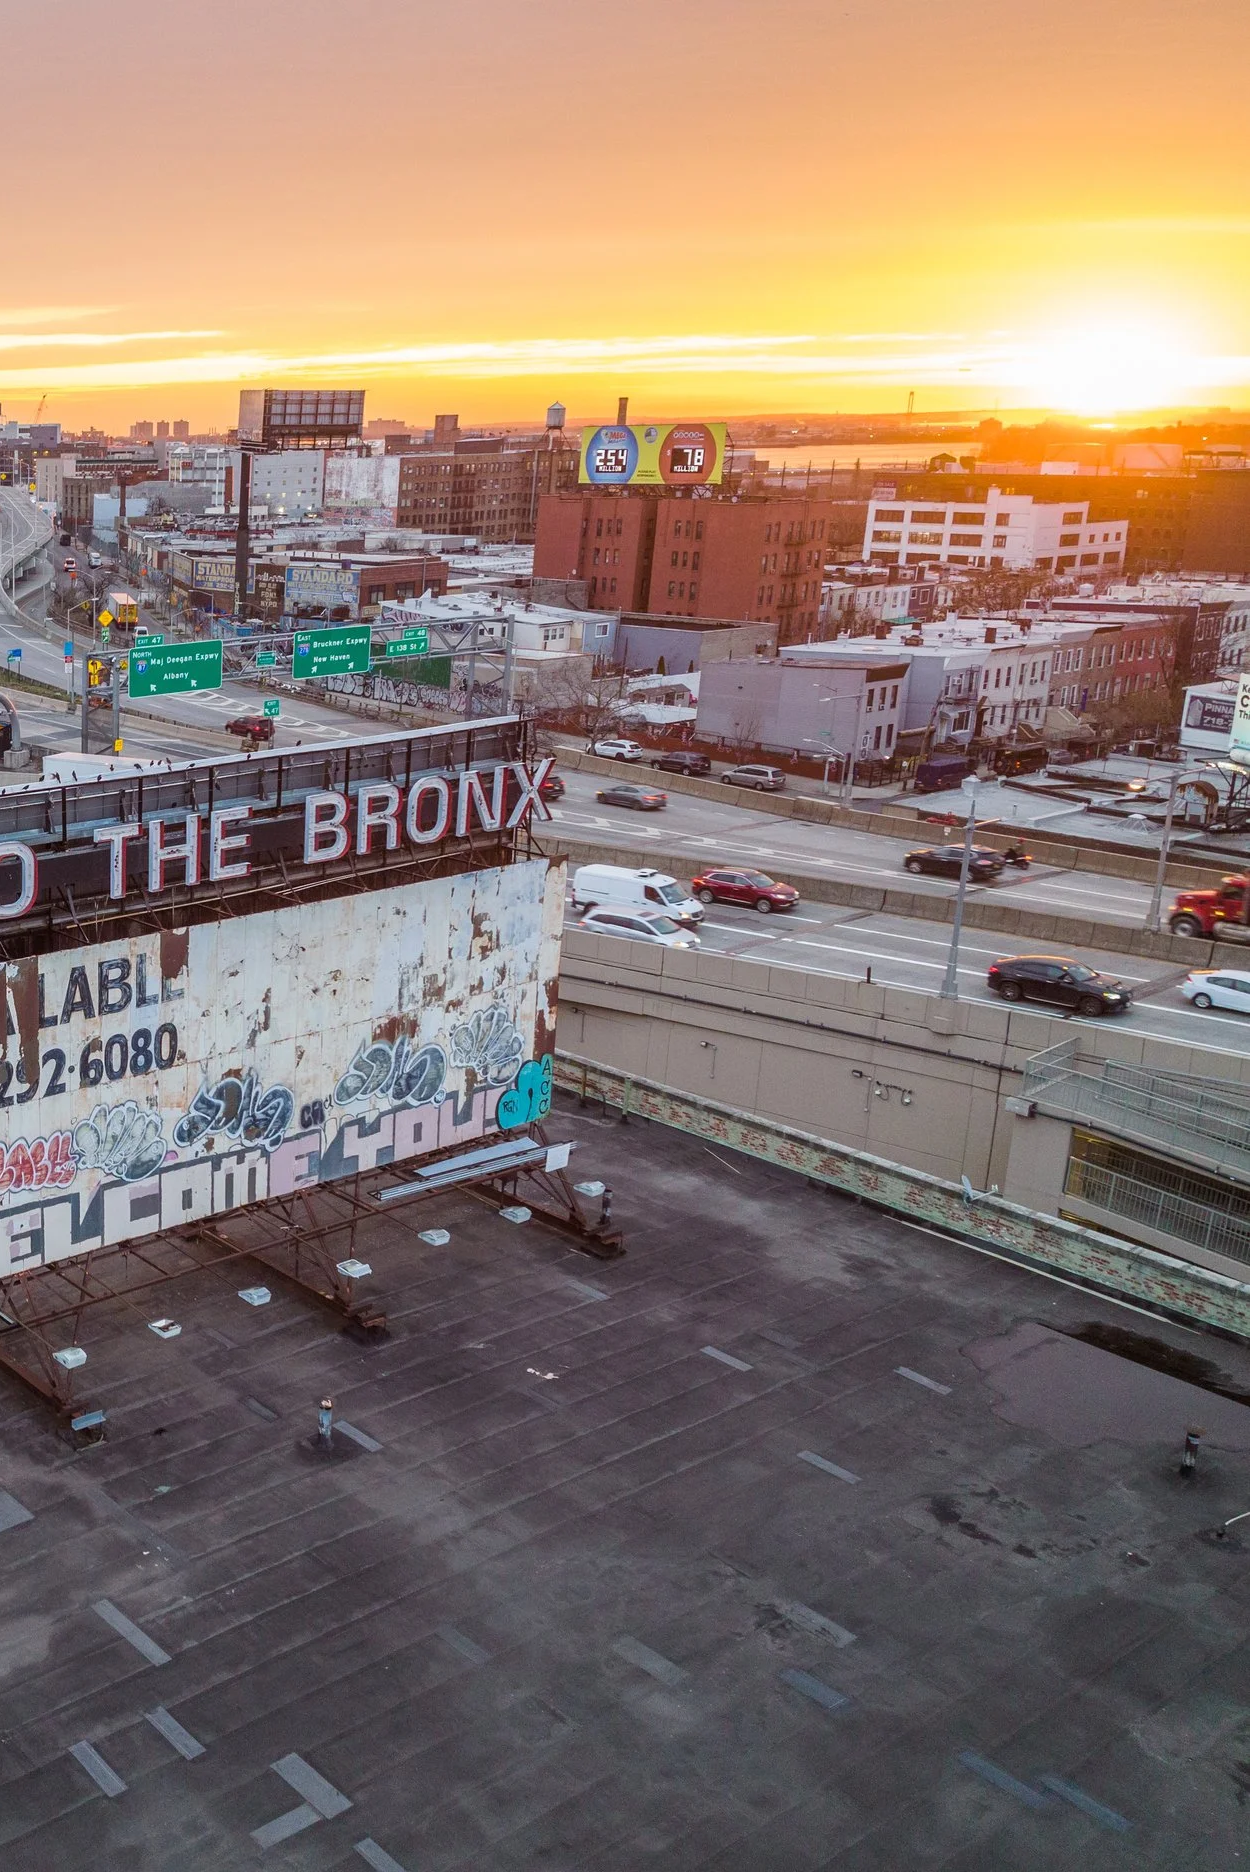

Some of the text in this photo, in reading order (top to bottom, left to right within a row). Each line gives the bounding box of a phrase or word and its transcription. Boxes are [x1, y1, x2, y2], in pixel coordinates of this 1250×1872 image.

[596, 449, 627, 466] 254
[683, 449, 705, 466] 78
[291, 568, 354, 585] STANDARD
[151, 636, 161, 644] 47
[297, 634, 311, 642] EAST
[313, 637, 368, 649] Bruckner Expwy
[396, 644, 408, 652] 138
[132, 651, 152, 659] NORTH
[150, 652, 219, 667] Maj Deegan Expwy
[313, 656, 328, 664] New
[163, 671, 189, 680] Albany
[92, 805, 254, 900] THE
[302, 756, 556, 866] BRONX
